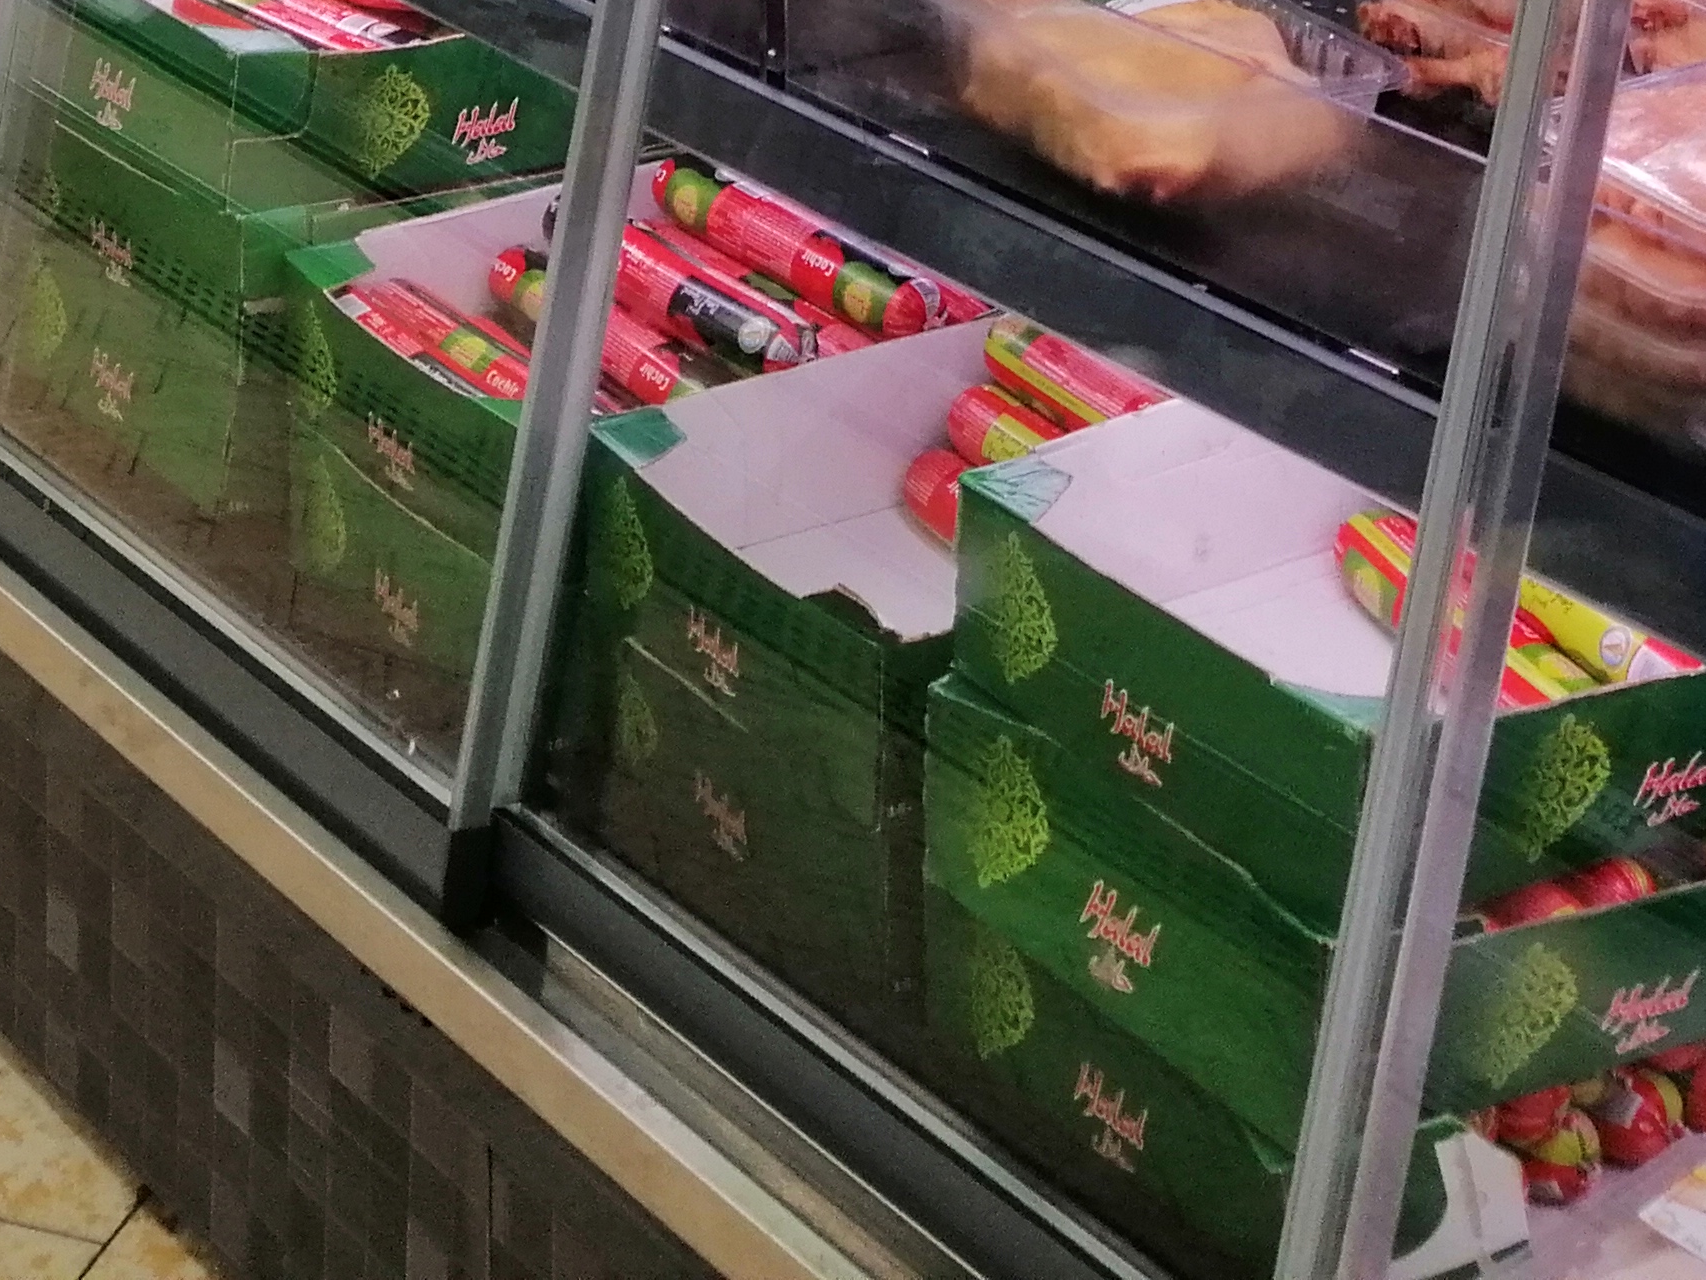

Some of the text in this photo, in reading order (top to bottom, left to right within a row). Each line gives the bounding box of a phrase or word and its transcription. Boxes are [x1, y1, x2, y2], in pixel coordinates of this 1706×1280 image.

[90, 57, 137, 111] Halal
[452, 96, 520, 145] Halal
[801, 249, 835, 278] Cochir
[485, 369, 520, 398] Cochir
[639, 364, 671, 392] Cochir
[687, 604, 739, 677] Halal
[1101, 678, 1174, 763] Halal
[1079, 878, 1161, 968] Halal
[1602, 967, 1700, 1035] Halal
[1074, 1061, 1148, 1150] Halal
